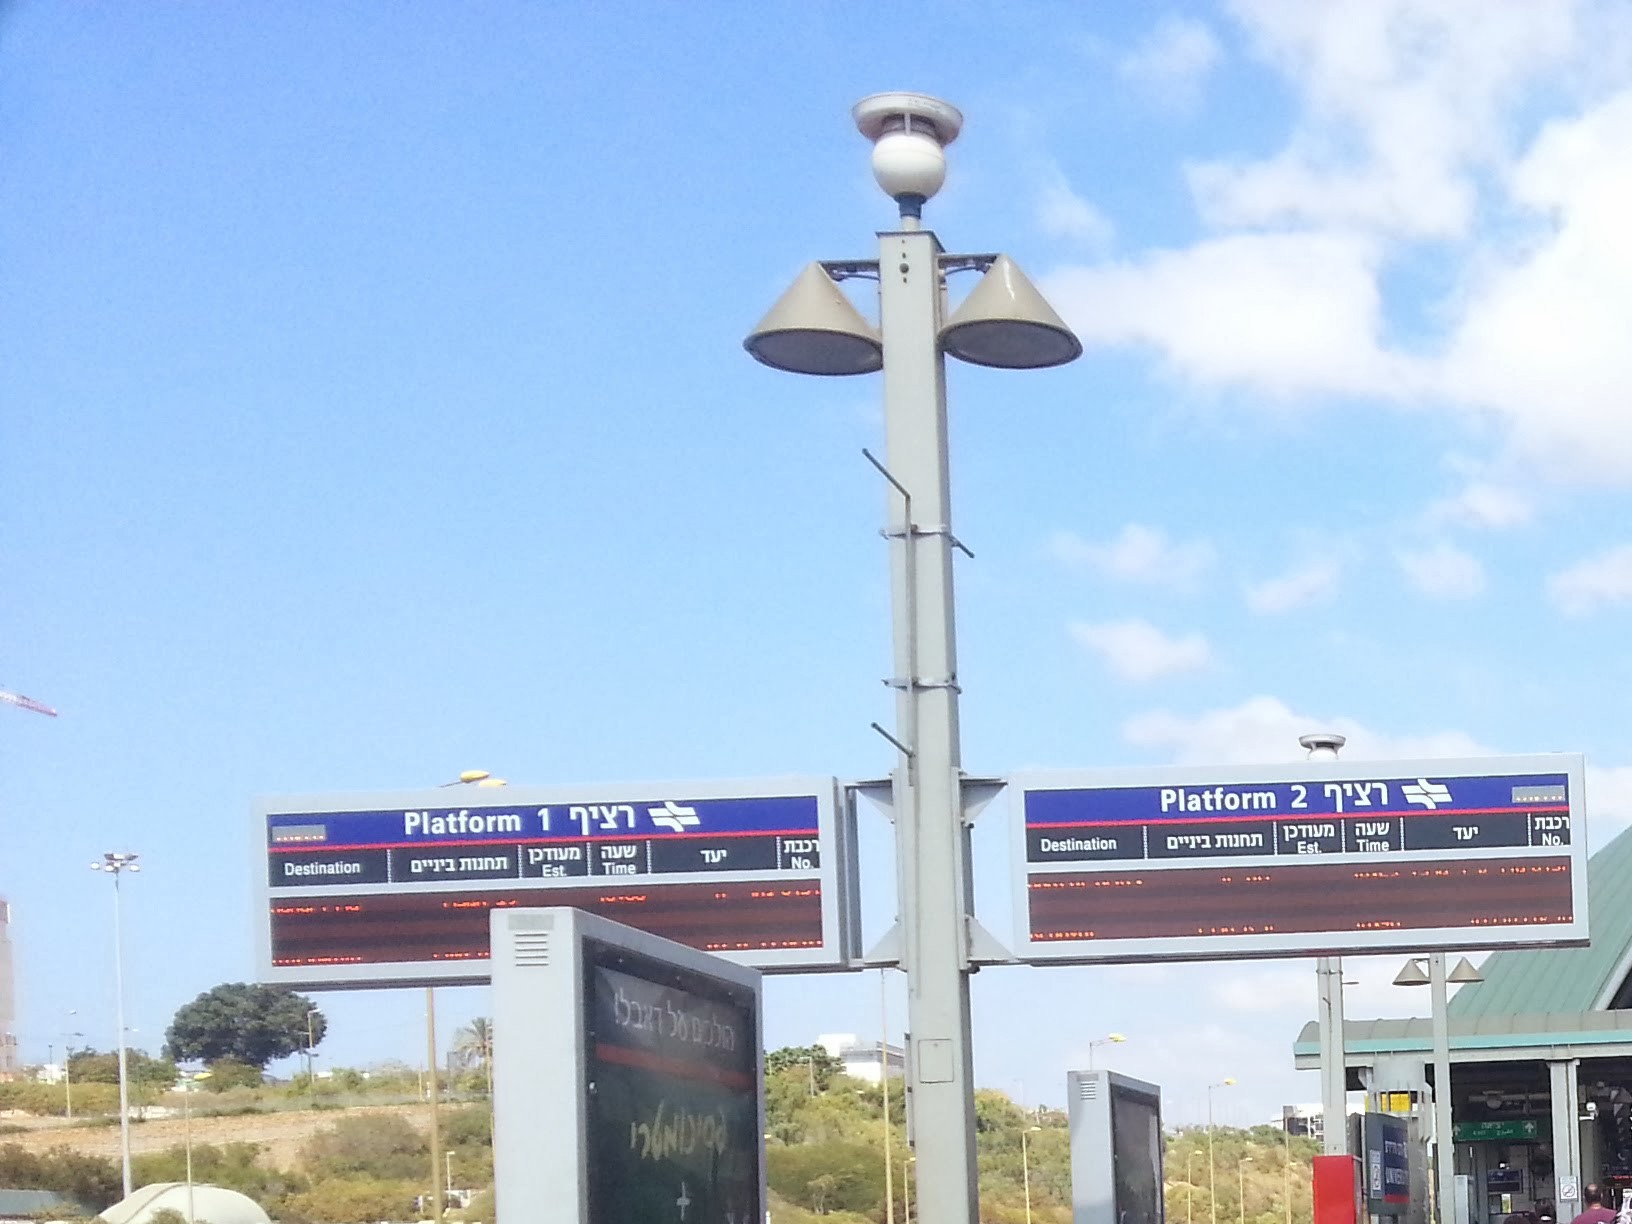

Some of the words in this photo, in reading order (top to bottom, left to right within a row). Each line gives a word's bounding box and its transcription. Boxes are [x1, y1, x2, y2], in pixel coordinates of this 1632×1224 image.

[1160, 787, 1277, 813] Platform
[1290, 785, 1308, 809] 2
[1324, 783, 1389, 813] רציף
[404, 809, 520, 835] Platform
[537, 807, 549, 831] 1
[569, 804, 635, 835] רציף
[1535, 816, 1570, 830] רכבת
[1284, 823, 1335, 842] מעודכן
[1355, 821, 1390, 836] שעה
[1453, 825, 1479, 842] יעד
[784, 839, 820, 854] רכבת
[1041, 836, 1117, 852] Destination
[1166, 834, 1212, 850] ביניים
[1215, 832, 1263, 847] תחנות
[1356, 838, 1389, 852] Time
[1542, 833, 1564, 846] No.
[528, 845, 581, 864] מעודכן
[601, 843, 636, 859] שעה
[1297, 840, 1322, 855] Est.
[701, 847, 726, 864] יעד
[284, 860, 361, 876] Destination
[411, 858, 456, 873] ביניים
[460, 856, 508, 871] תחנות
[542, 865, 566, 877] Est.
[602, 860, 636, 875] Time
[791, 857, 814, 870] No.
